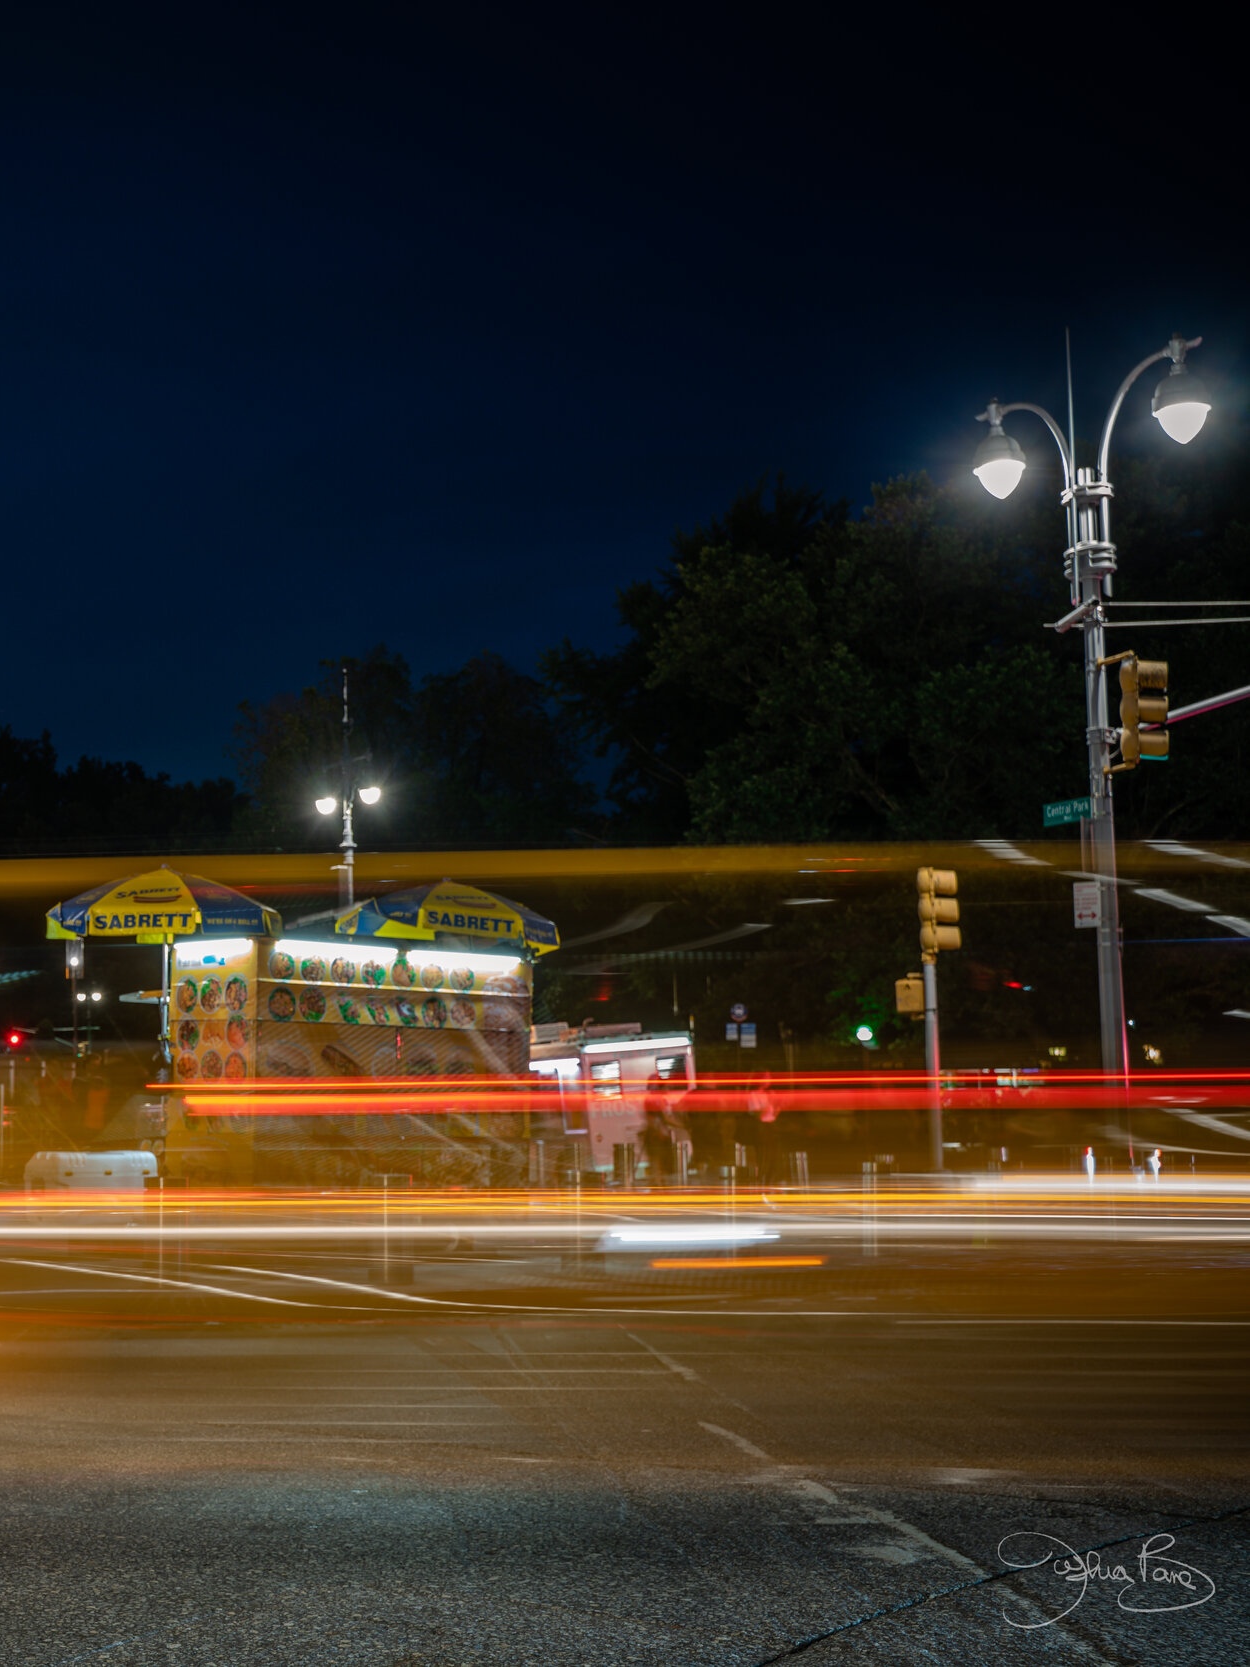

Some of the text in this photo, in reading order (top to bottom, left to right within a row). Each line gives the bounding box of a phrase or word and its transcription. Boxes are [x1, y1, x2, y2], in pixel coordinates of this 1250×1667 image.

[1046, 802, 1072, 818] Central
[1072, 800, 1089, 813] Park
[94, 912, 192, 930] SABRETT
[427, 911, 515, 933] SABRETT
